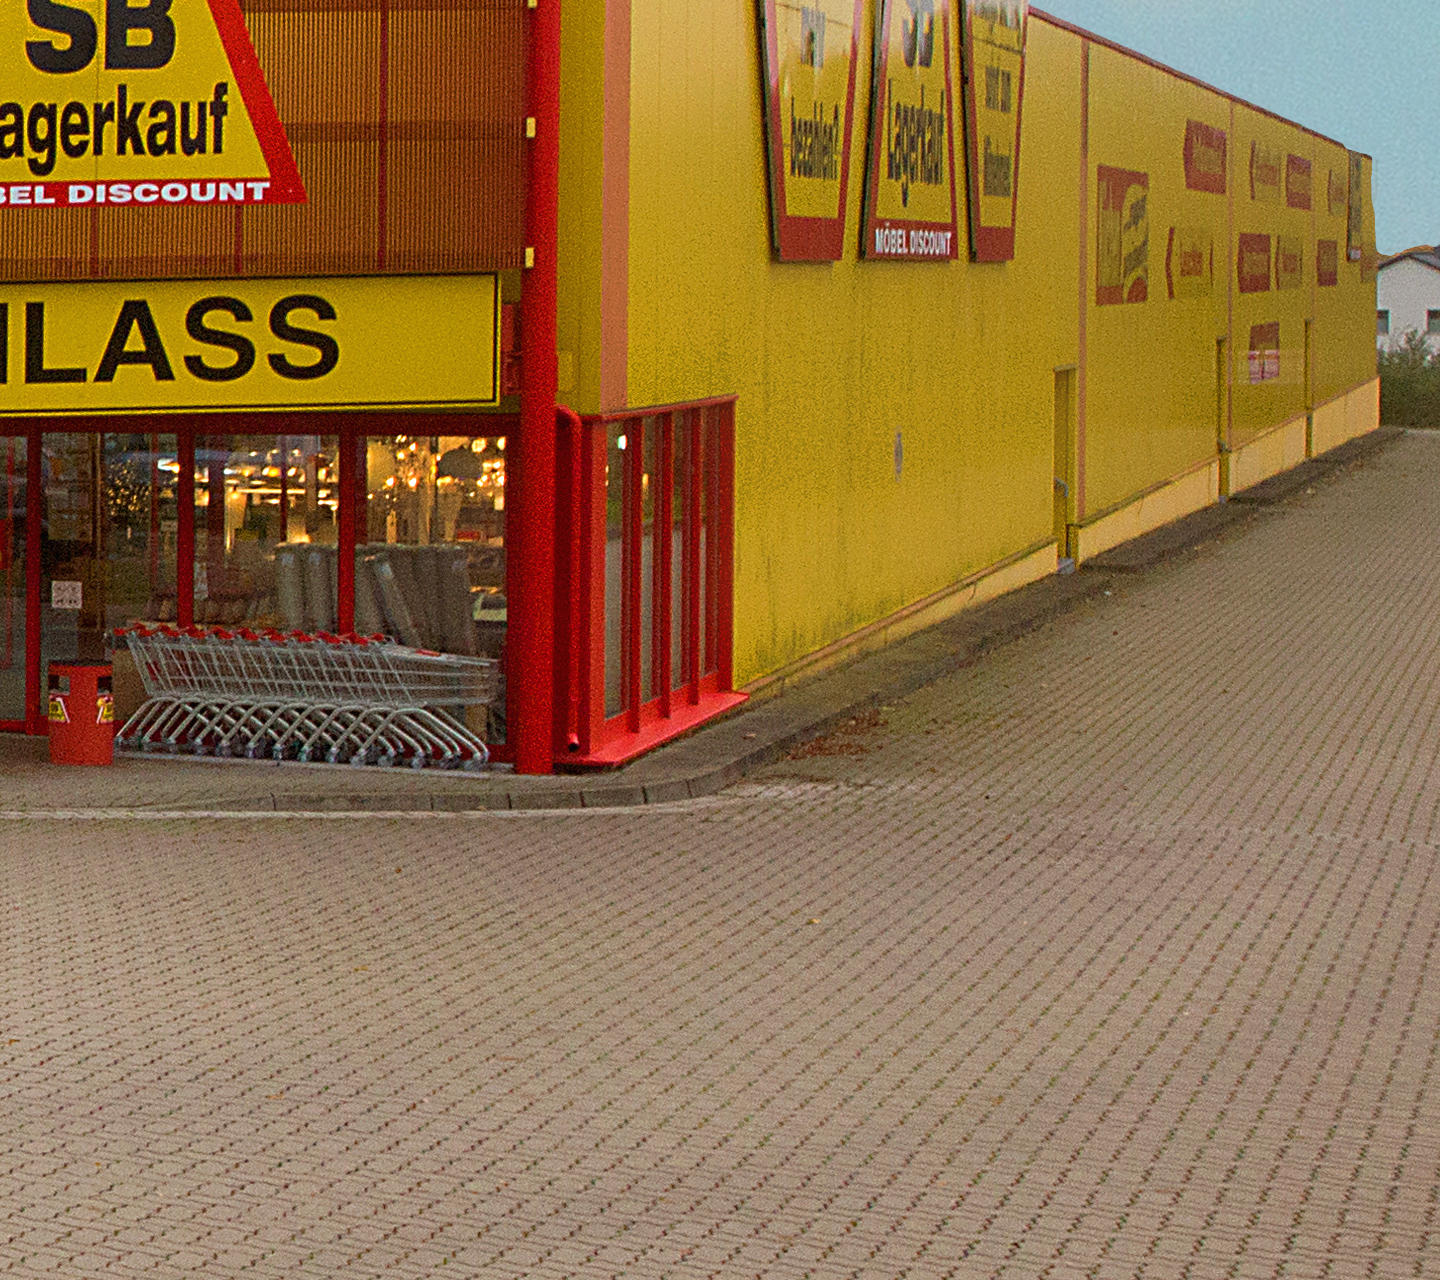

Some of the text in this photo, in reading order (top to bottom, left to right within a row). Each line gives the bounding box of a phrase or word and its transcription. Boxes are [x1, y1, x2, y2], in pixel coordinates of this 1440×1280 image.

[887, 78, 944, 208] Lagerkauf
[68, 181, 270, 204] DISCOUNT
[875, 222, 951, 256] MÖBEL DISCOUNT
